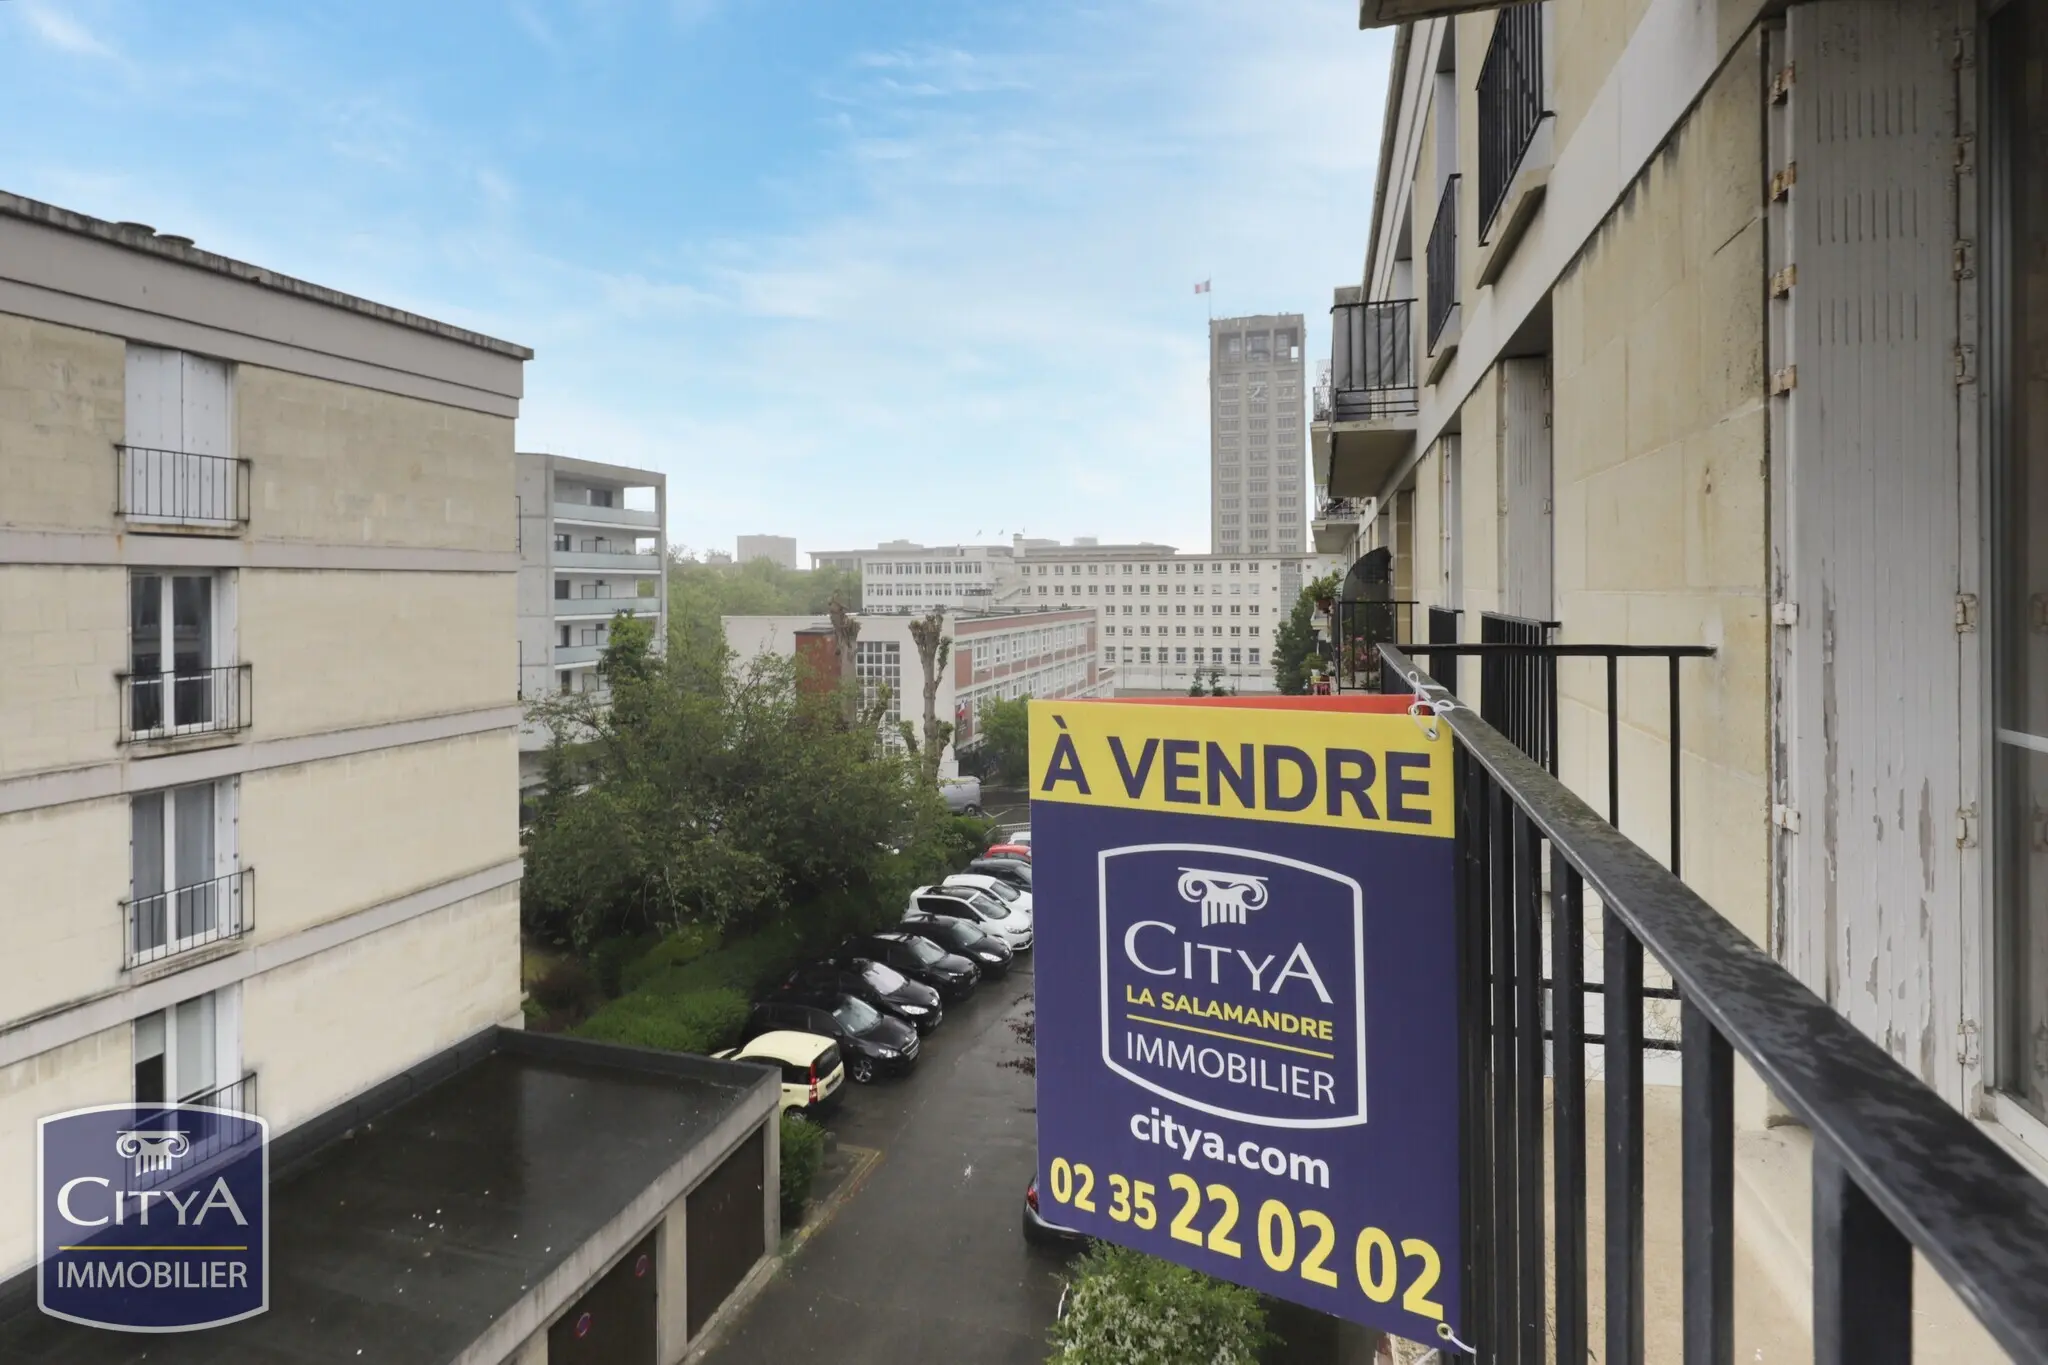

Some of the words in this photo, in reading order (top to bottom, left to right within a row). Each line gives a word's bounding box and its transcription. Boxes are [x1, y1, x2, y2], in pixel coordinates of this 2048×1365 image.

[1041, 715, 1092, 795] À
[1107, 736, 1432, 825] VENDRE
[1126, 985, 1156, 1008] LA
[1161, 990, 1334, 1041] SALAMANDRE
[1127, 1032, 1336, 1105] IMMOBILIER
[1130, 1107, 1330, 1189] citya.com
[1050, 1157, 1096, 1213] 02
[1108, 1174, 1157, 1230] 35
[1169, 1173, 1242, 1258] 22
[1258, 1199, 1338, 1289] 02
[1355, 1226, 1444, 1321] 02
